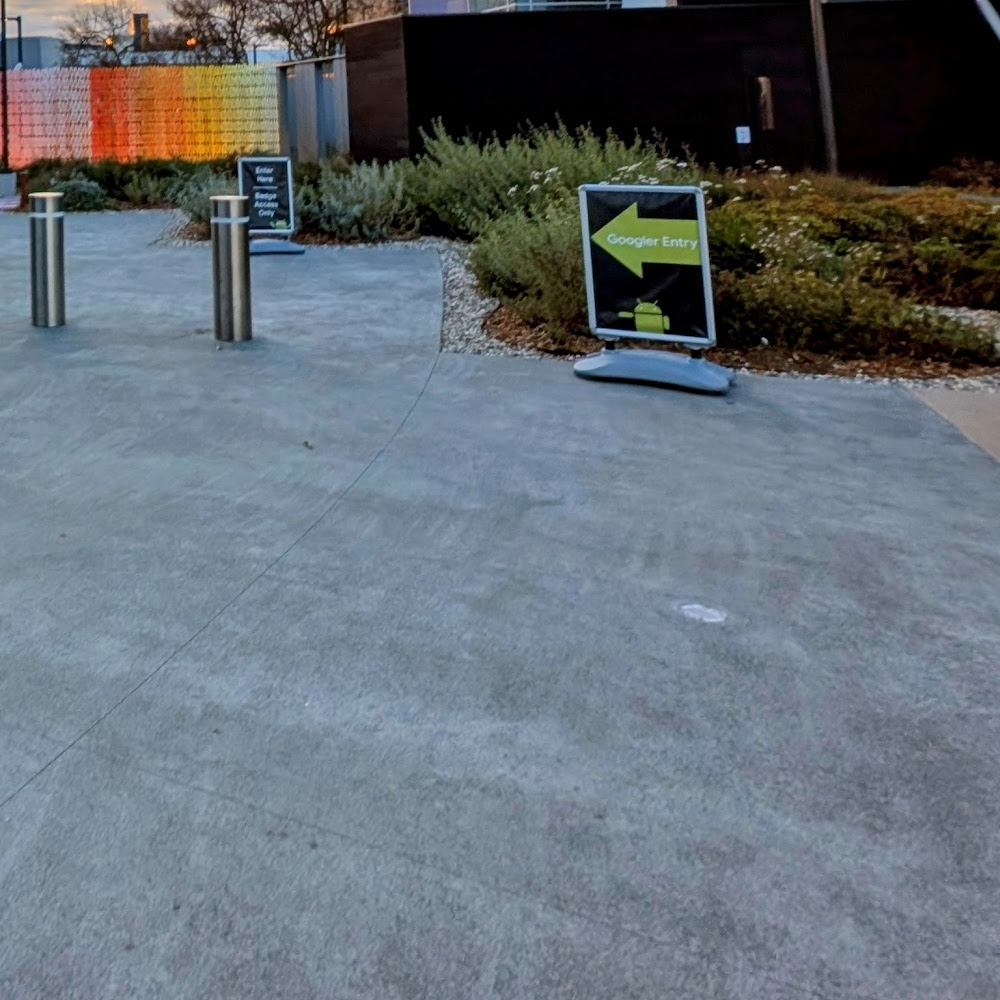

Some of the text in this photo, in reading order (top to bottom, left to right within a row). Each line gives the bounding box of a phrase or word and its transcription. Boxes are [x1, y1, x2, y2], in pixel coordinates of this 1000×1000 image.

[255, 166, 274, 174] Enter
[254, 192, 277, 201] Badge
[258, 209, 275, 218] Only
[607, 233, 699, 250] Googler Entry
